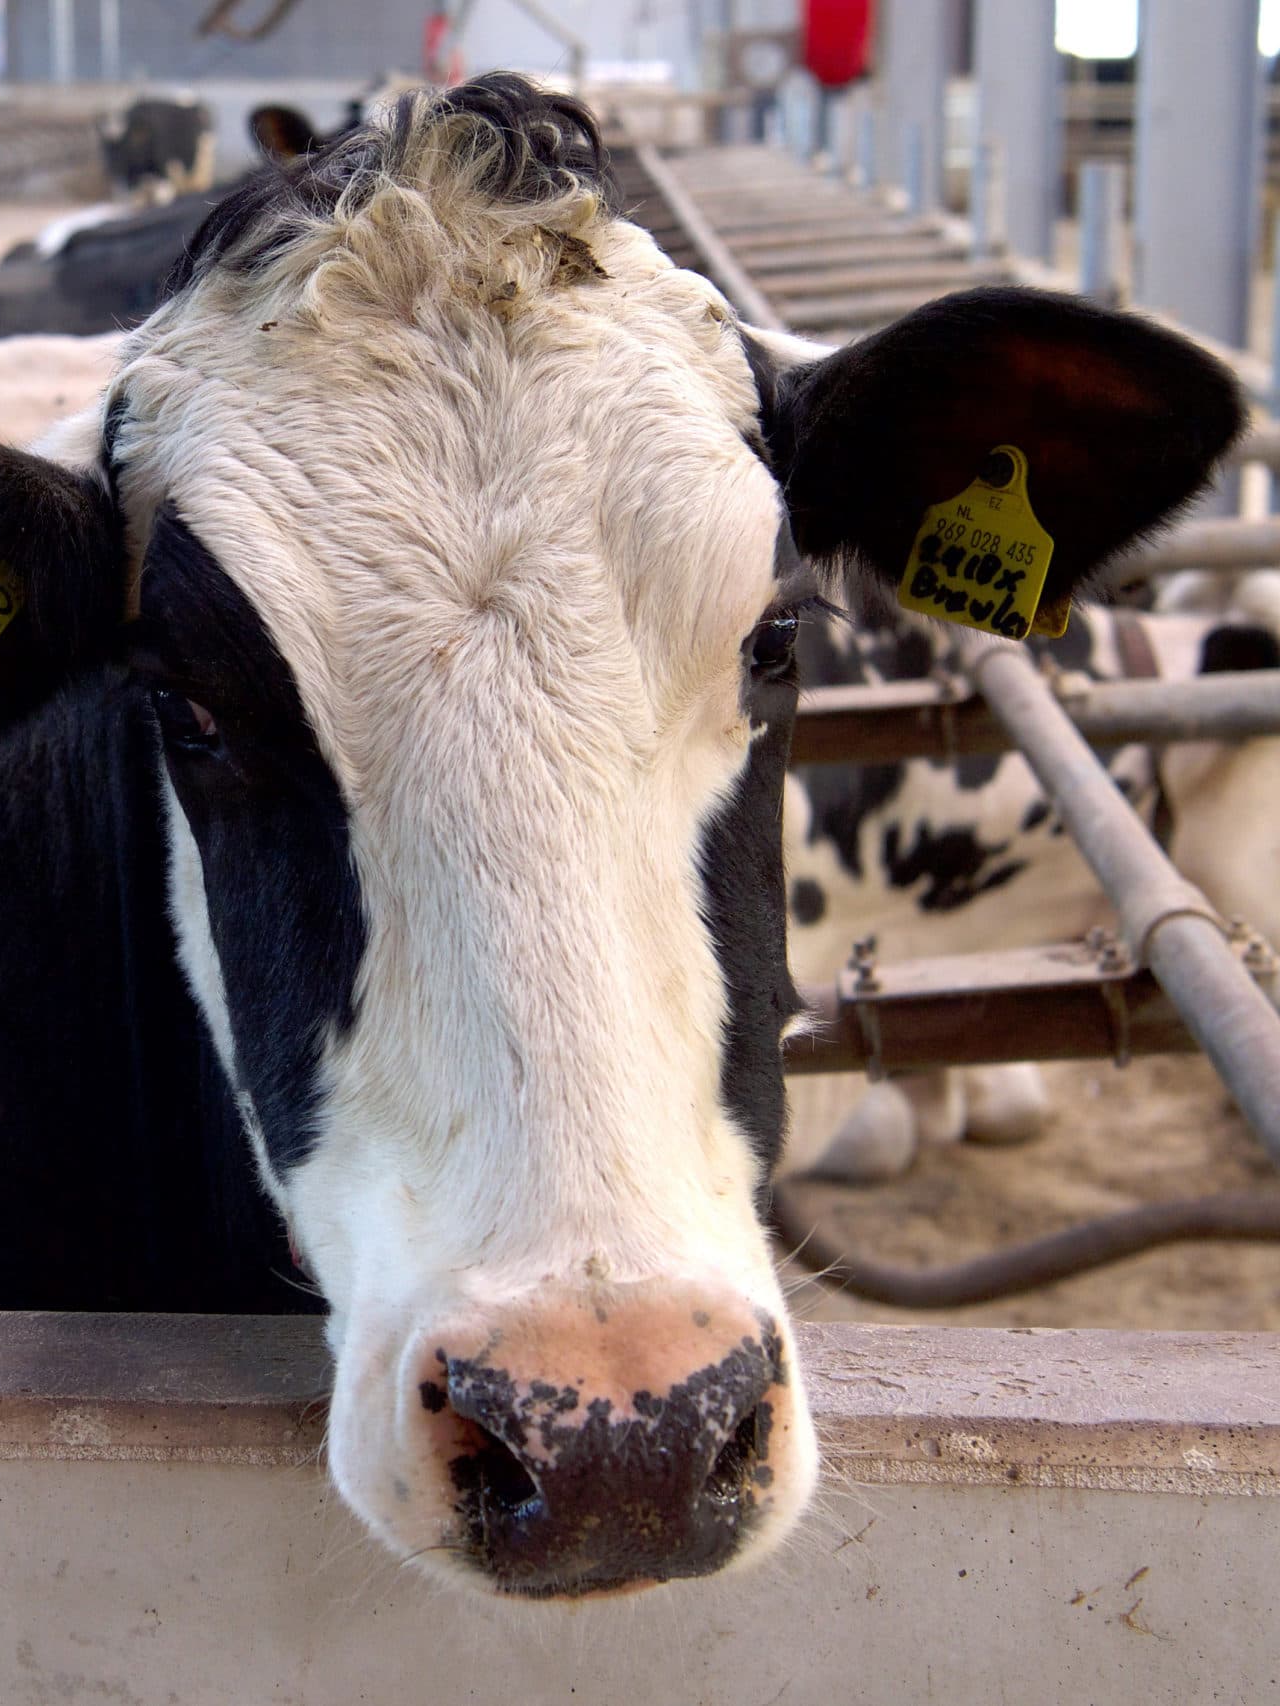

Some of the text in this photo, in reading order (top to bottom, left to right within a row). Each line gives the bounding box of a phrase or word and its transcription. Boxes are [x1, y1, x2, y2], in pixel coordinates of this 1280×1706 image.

[956, 504, 974, 521] NL
[988, 497, 1004, 512] EZ
[936, 518, 1037, 566] 969 028 435
